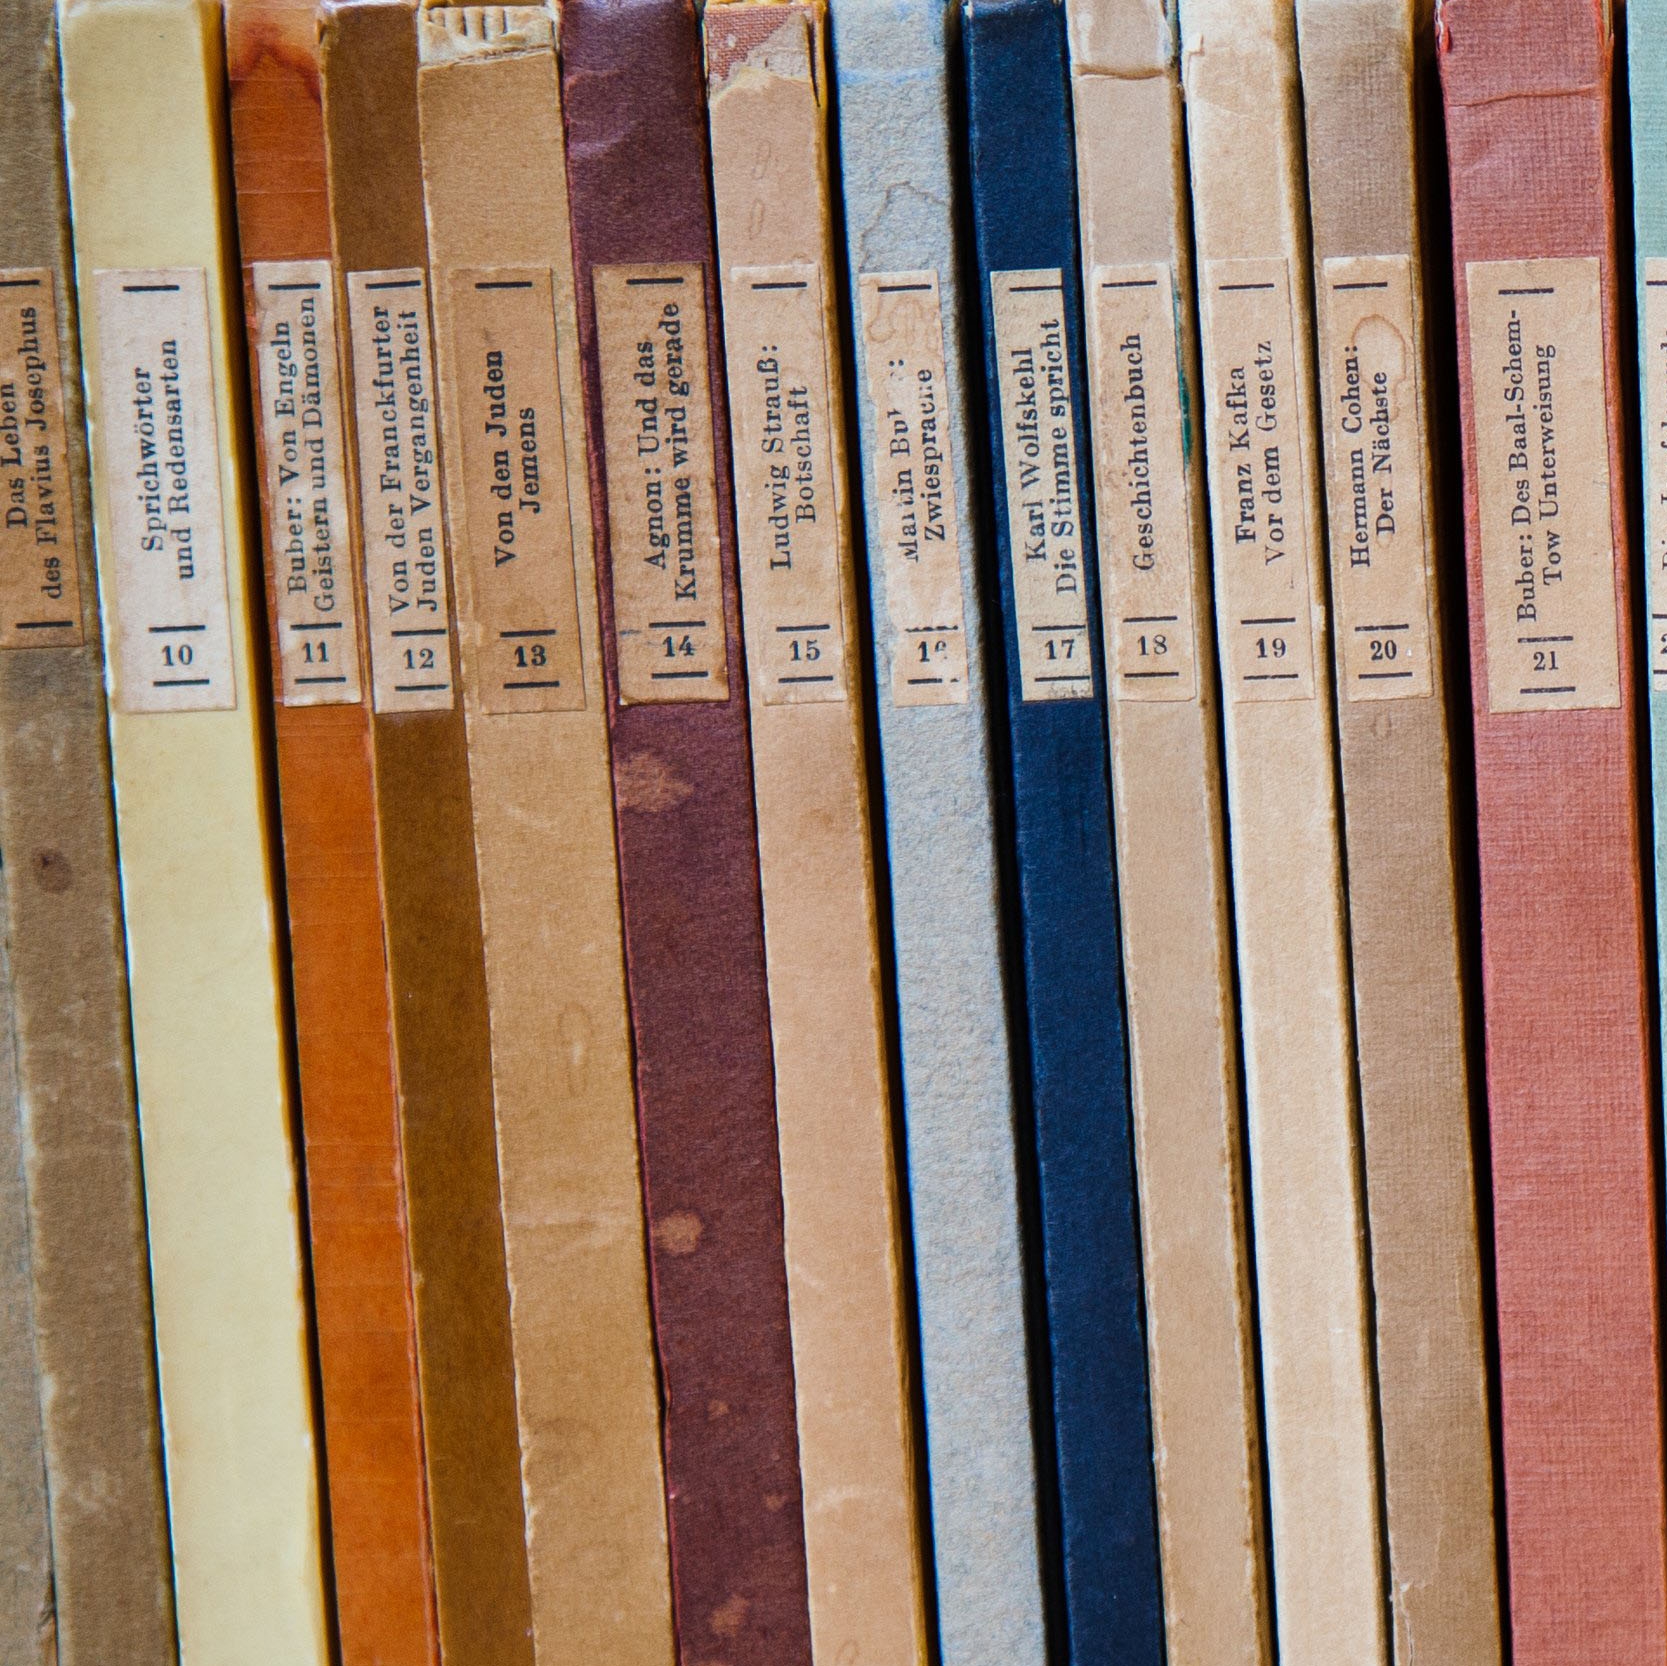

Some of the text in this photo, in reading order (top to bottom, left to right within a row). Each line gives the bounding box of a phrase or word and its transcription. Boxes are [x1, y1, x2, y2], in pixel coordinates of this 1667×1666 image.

[17, 307, 62, 599] des Flavius Josephus
[133, 367, 167, 551] Sprichwörter
[160, 340, 194, 579] und Redensarten
[270, 321, 307, 595] Buber: Von Engeln
[301, 297, 334, 612] Geistern und Dämonen
[372, 306, 409, 613] Von der Franckfurter
[397, 311, 437, 612] Juden Vergangenheit
[483, 351, 516, 567] Von den Juden
[519, 408, 540, 514] Jemens
[634, 341, 670, 570] Agnon: Und das
[657, 302, 696, 600] Krumme wird gerade
[757, 346, 791, 570] Ludwig Strauß:
[787, 386, 816, 523] Botschaft
[1011, 348, 1046, 562] Karl Wolfskehl
[1040, 319, 1077, 594] Die Stimme spricht
[1120, 333, 1154, 570] Geschichtenbuch
[1226, 367, 1256, 543] Franz Kafka
[1254, 341, 1284, 565] Vor dem Gesetz
[1341, 346, 1370, 568] Hermann Cohen:
[1370, 373, 1395, 536] Der Nächste
[1502, 310, 1536, 622] Buber: Des Baal-Schem-
[1533, 345, 1562, 586] Tow Unterweisung
[162, 645, 192, 666] 10
[302, 642, 328, 663] 11
[404, 648, 433, 669] 12
[515, 645, 546, 667] 13
[790, 640, 820, 661] 15
[1045, 639, 1074, 660] 17
[1138, 635, 1167, 655] 18
[1256, 638, 1286, 658] 19
[1370, 640, 1396, 661] 20
[1534, 651, 1558, 671] 21
